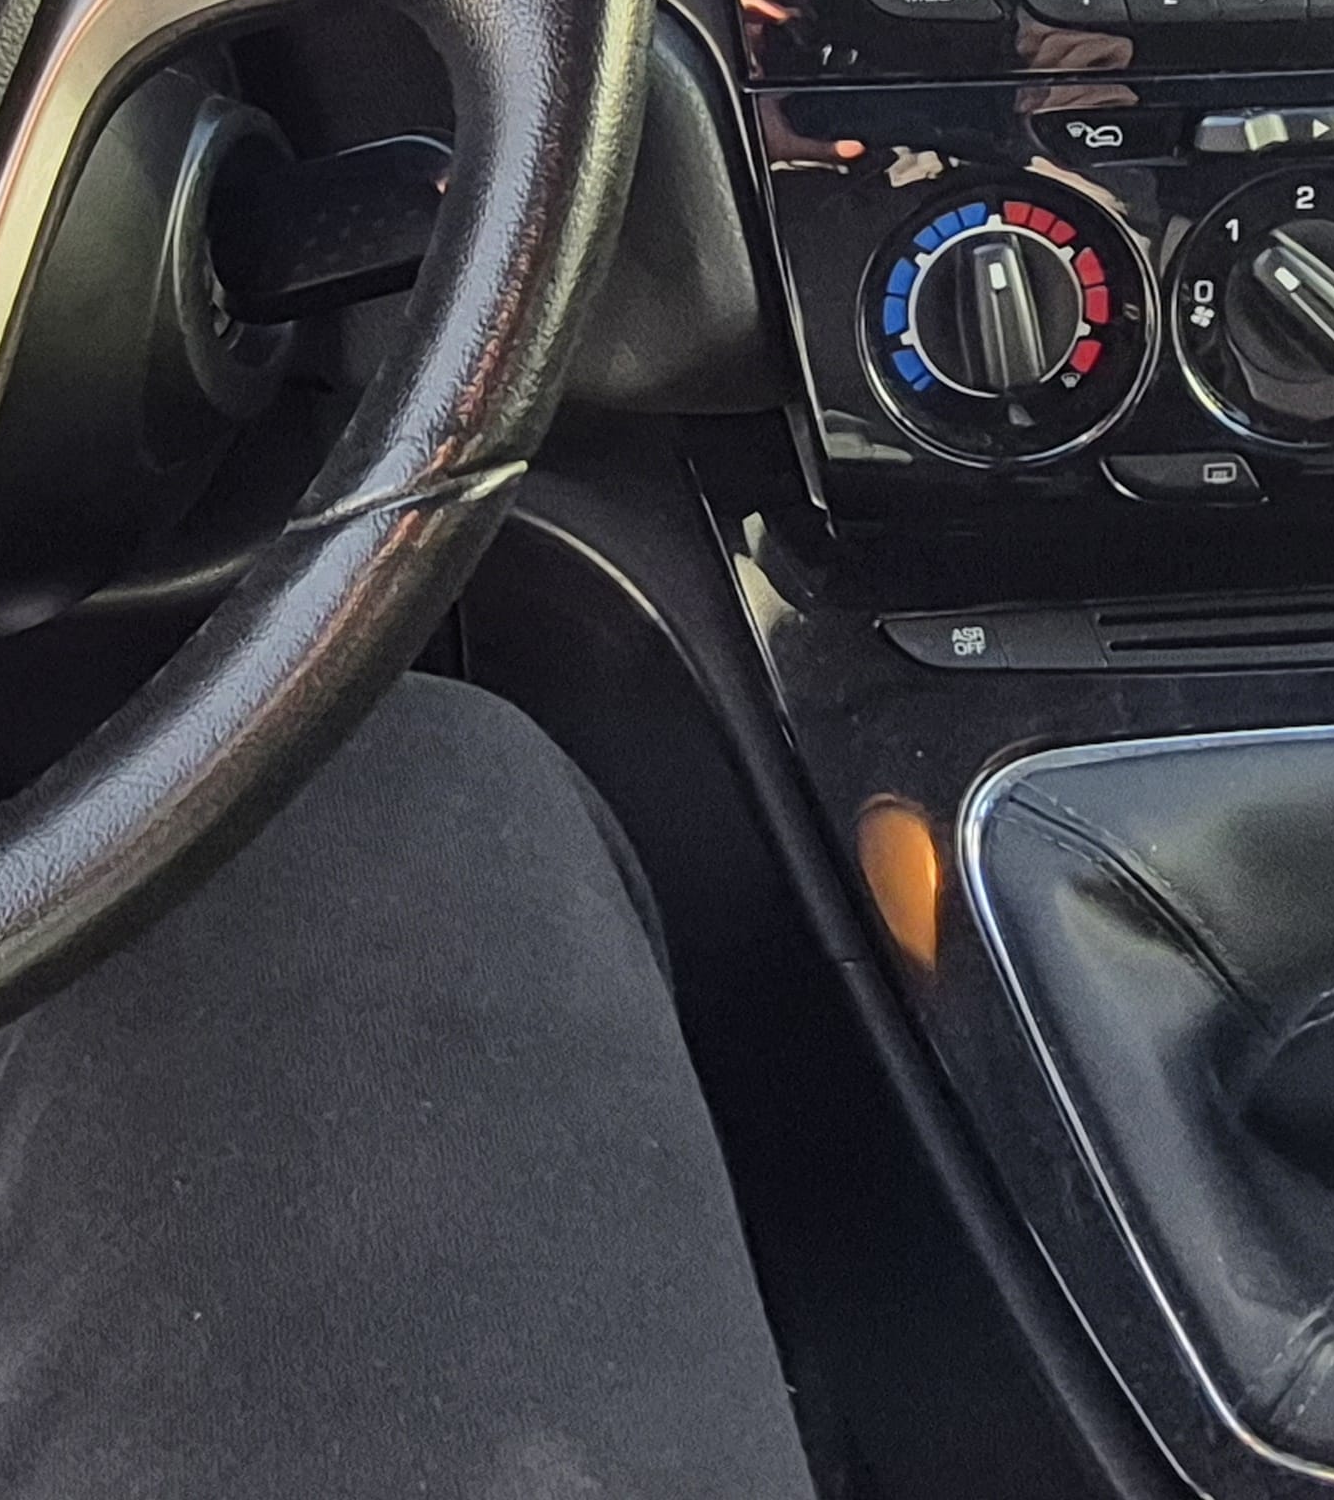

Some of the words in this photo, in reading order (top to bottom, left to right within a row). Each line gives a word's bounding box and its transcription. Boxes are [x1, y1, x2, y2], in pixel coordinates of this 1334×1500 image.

[1295, 186, 1315, 210] 2
[1224, 218, 1240, 242] 1
[1194, 280, 1214, 303] 0
[951, 626, 985, 643] ASR
[953, 641, 986, 656] OFF
